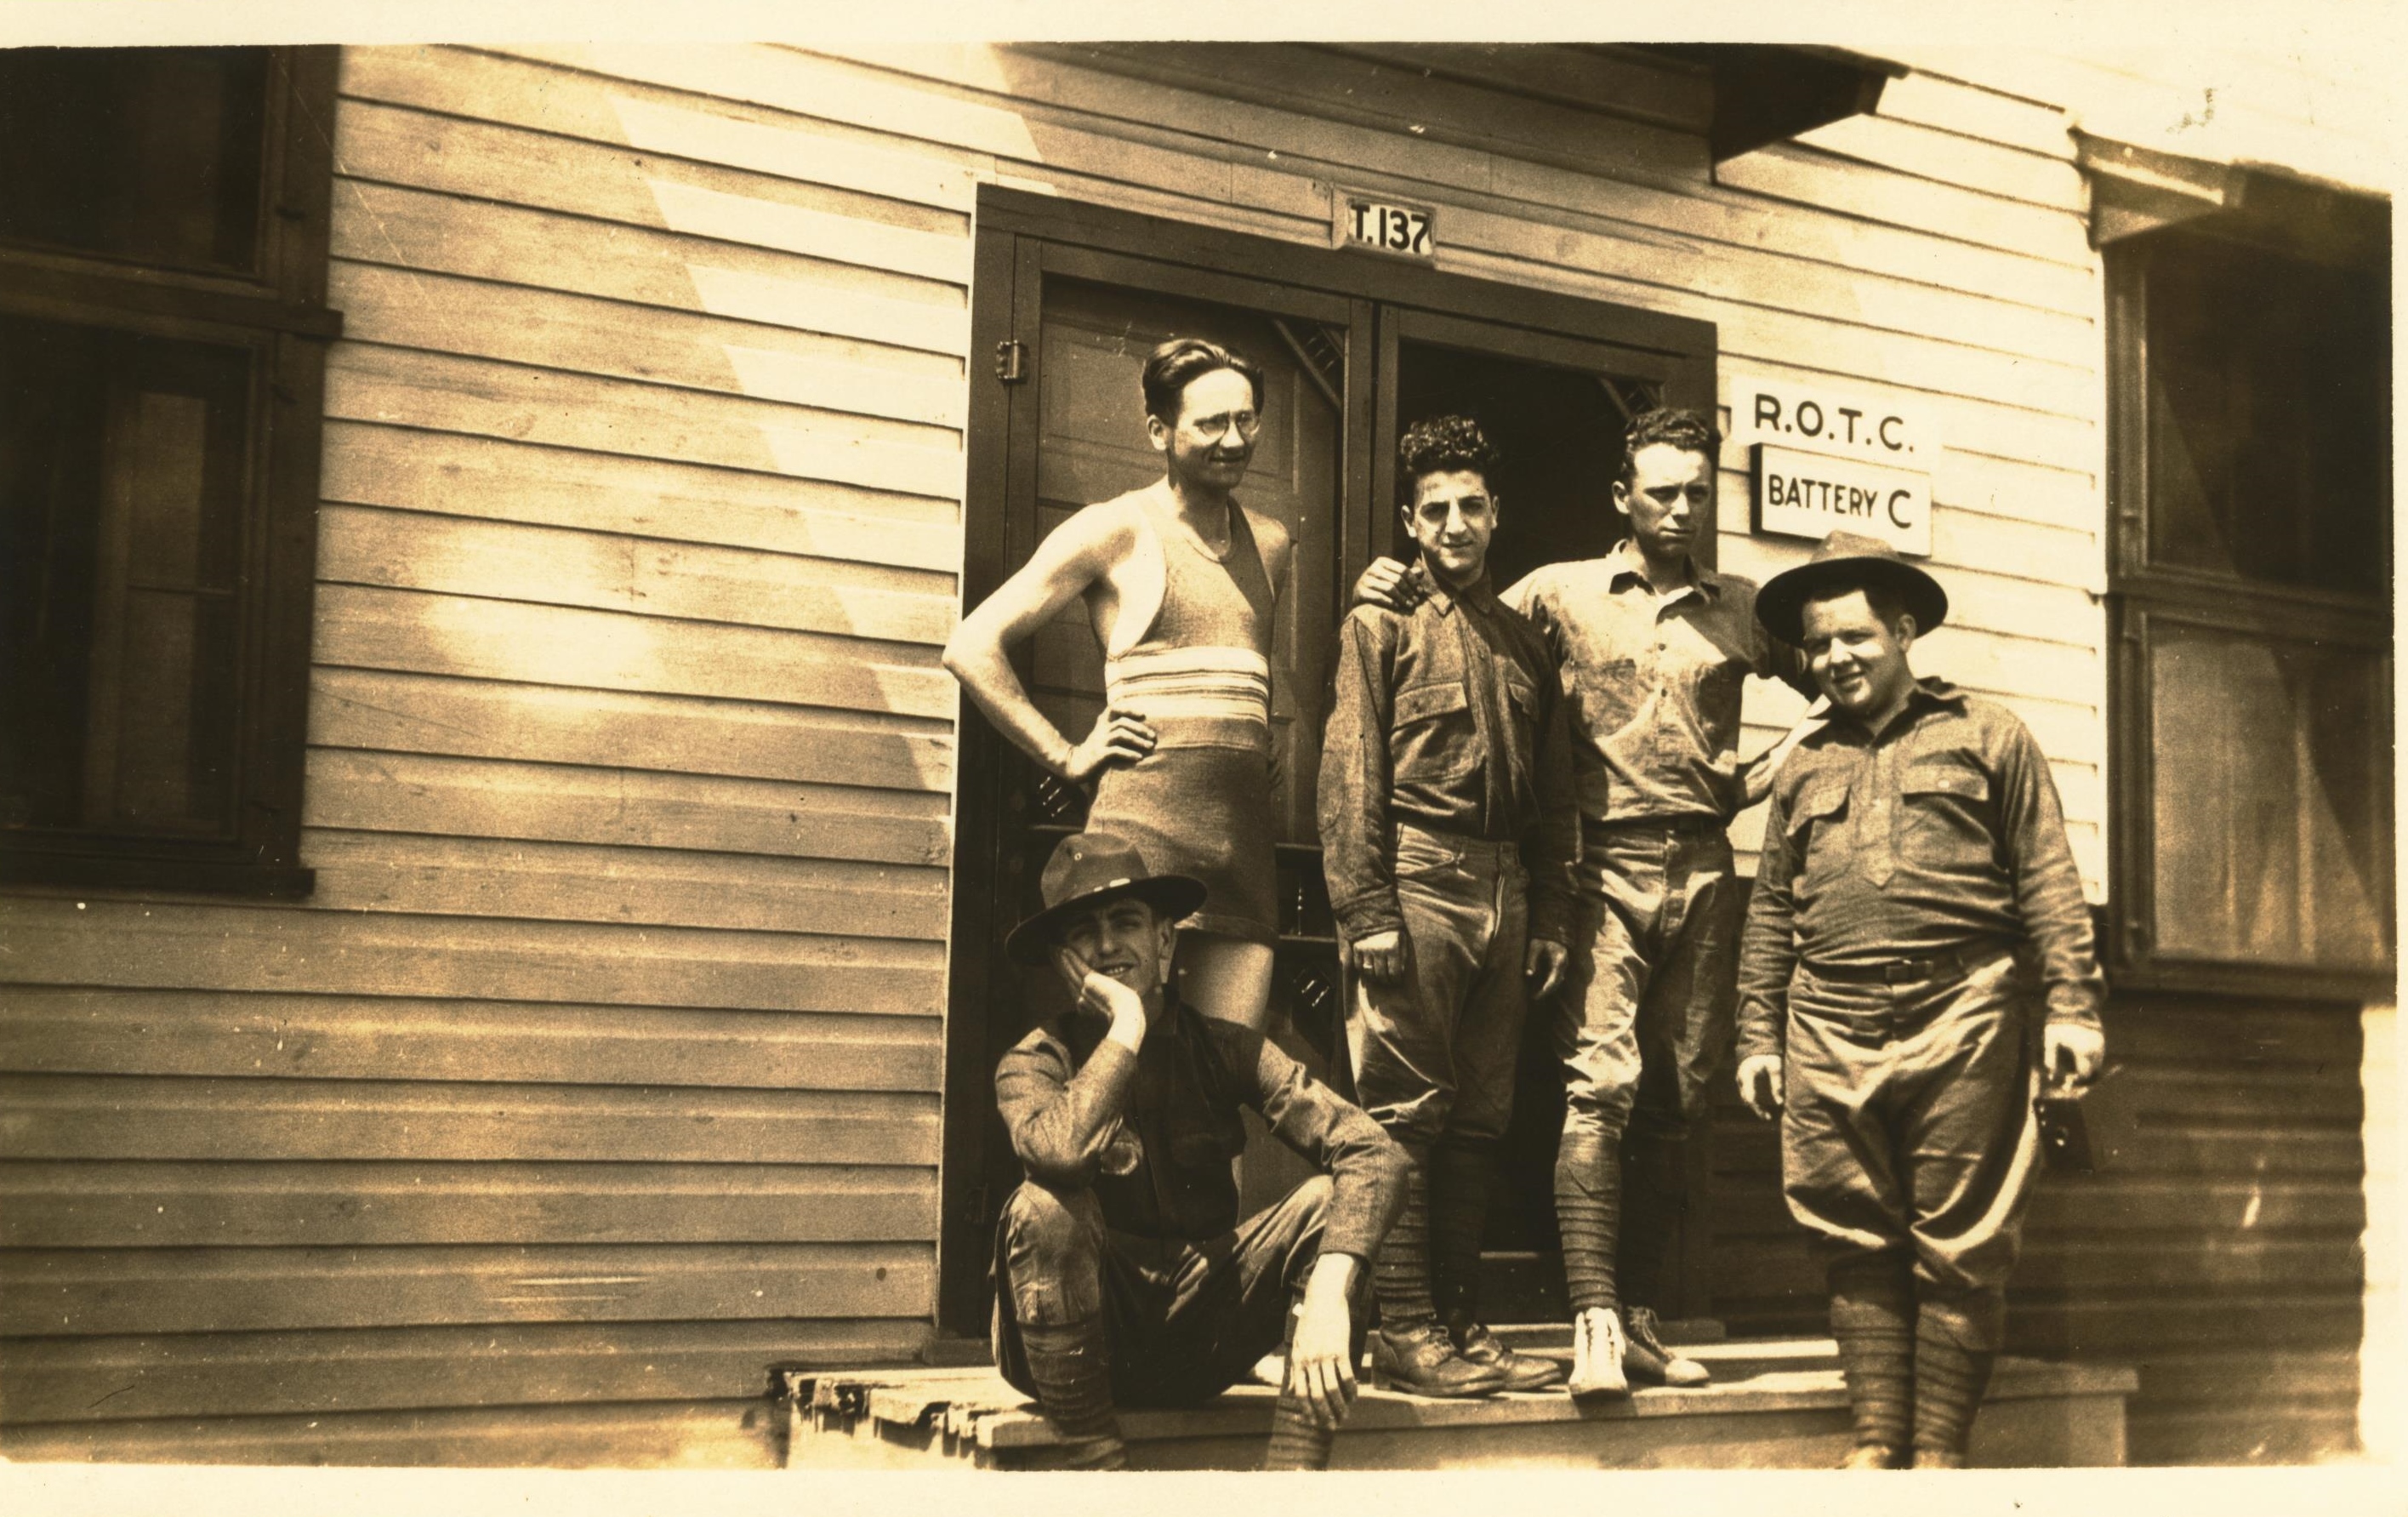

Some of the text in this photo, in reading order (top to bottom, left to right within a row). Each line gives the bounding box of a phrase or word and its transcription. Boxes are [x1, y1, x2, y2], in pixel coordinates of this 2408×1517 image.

[1350, 203, 1431, 254] T.137
[1755, 393, 1914, 453] R.O.T.C.
[1768, 474, 1912, 529] BATTERY C
